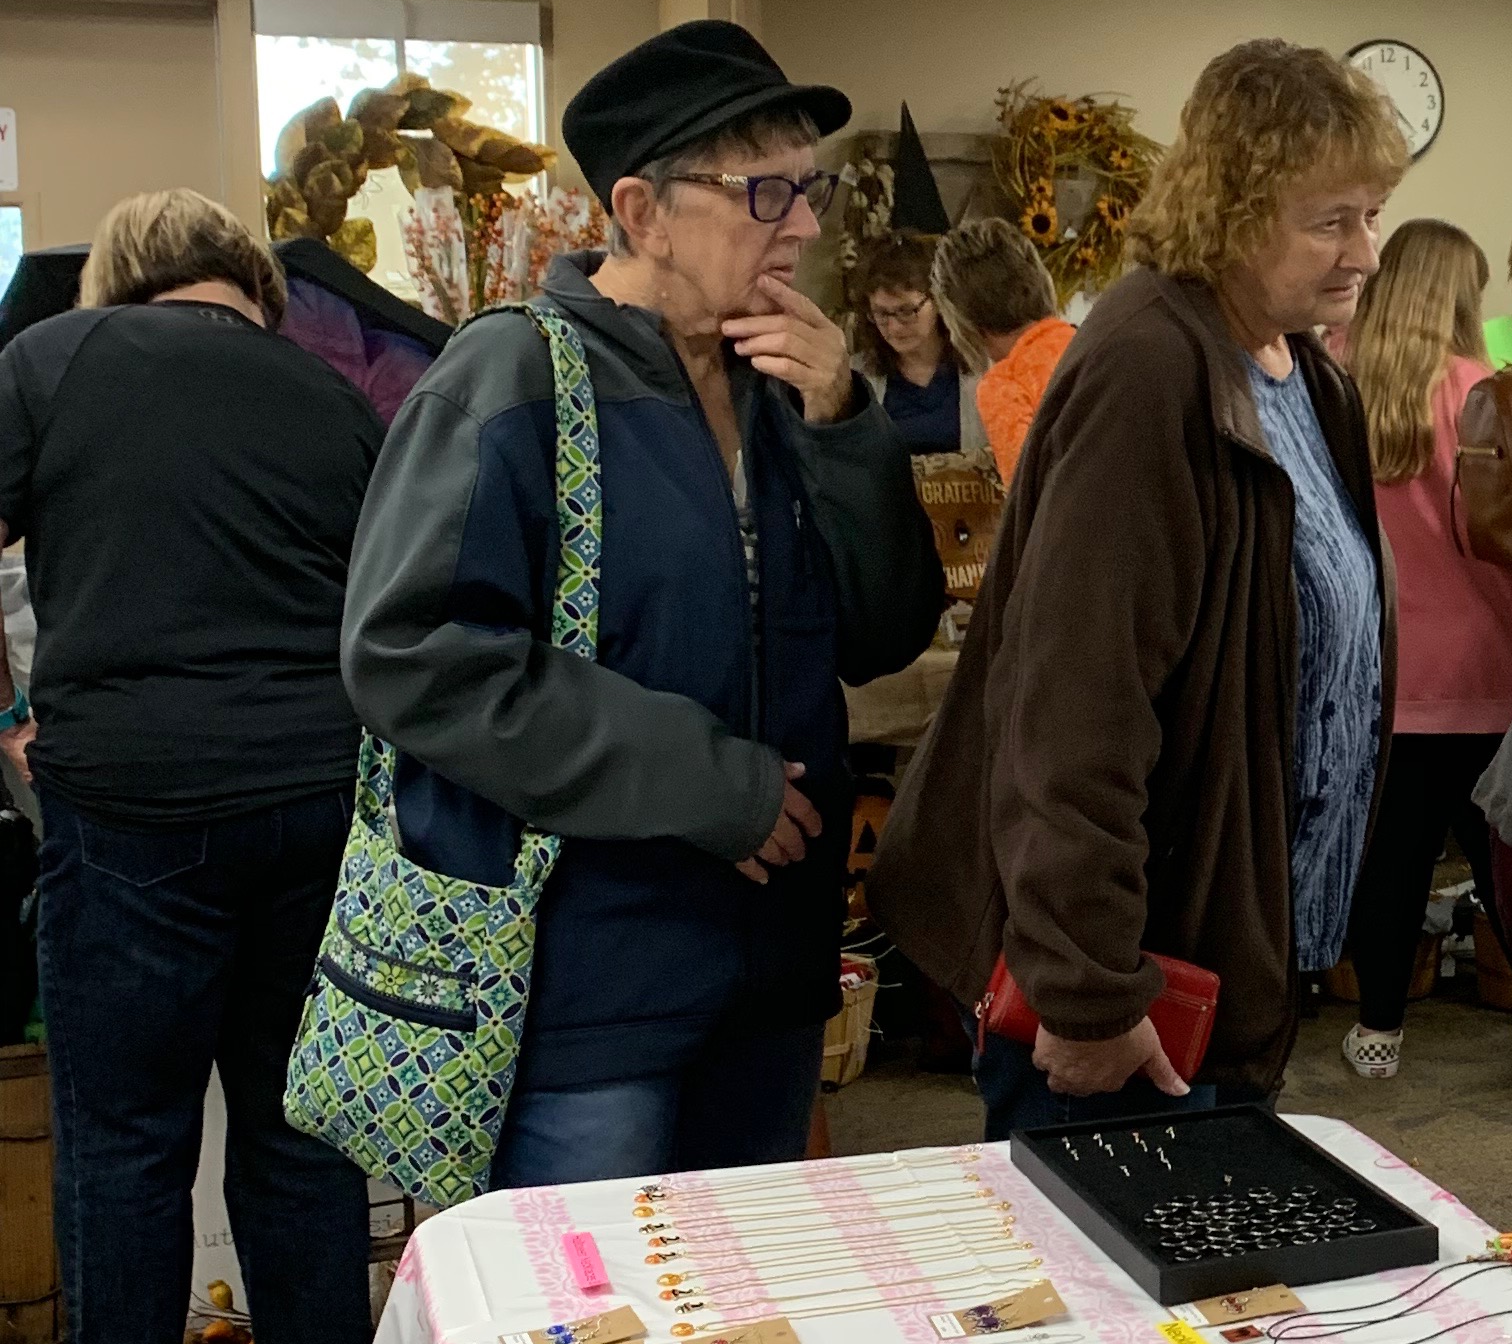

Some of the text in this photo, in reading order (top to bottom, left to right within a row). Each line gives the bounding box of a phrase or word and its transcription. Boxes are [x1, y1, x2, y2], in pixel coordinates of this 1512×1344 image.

[1381, 47, 1396, 63] 12
[1403, 55, 1410, 71] 1
[1419, 71, 1429, 87] 2
[1426, 94, 1437, 110] 3
[1421, 118, 1430, 131] 4
[921, 480, 1001, 505] GRATEFUL
